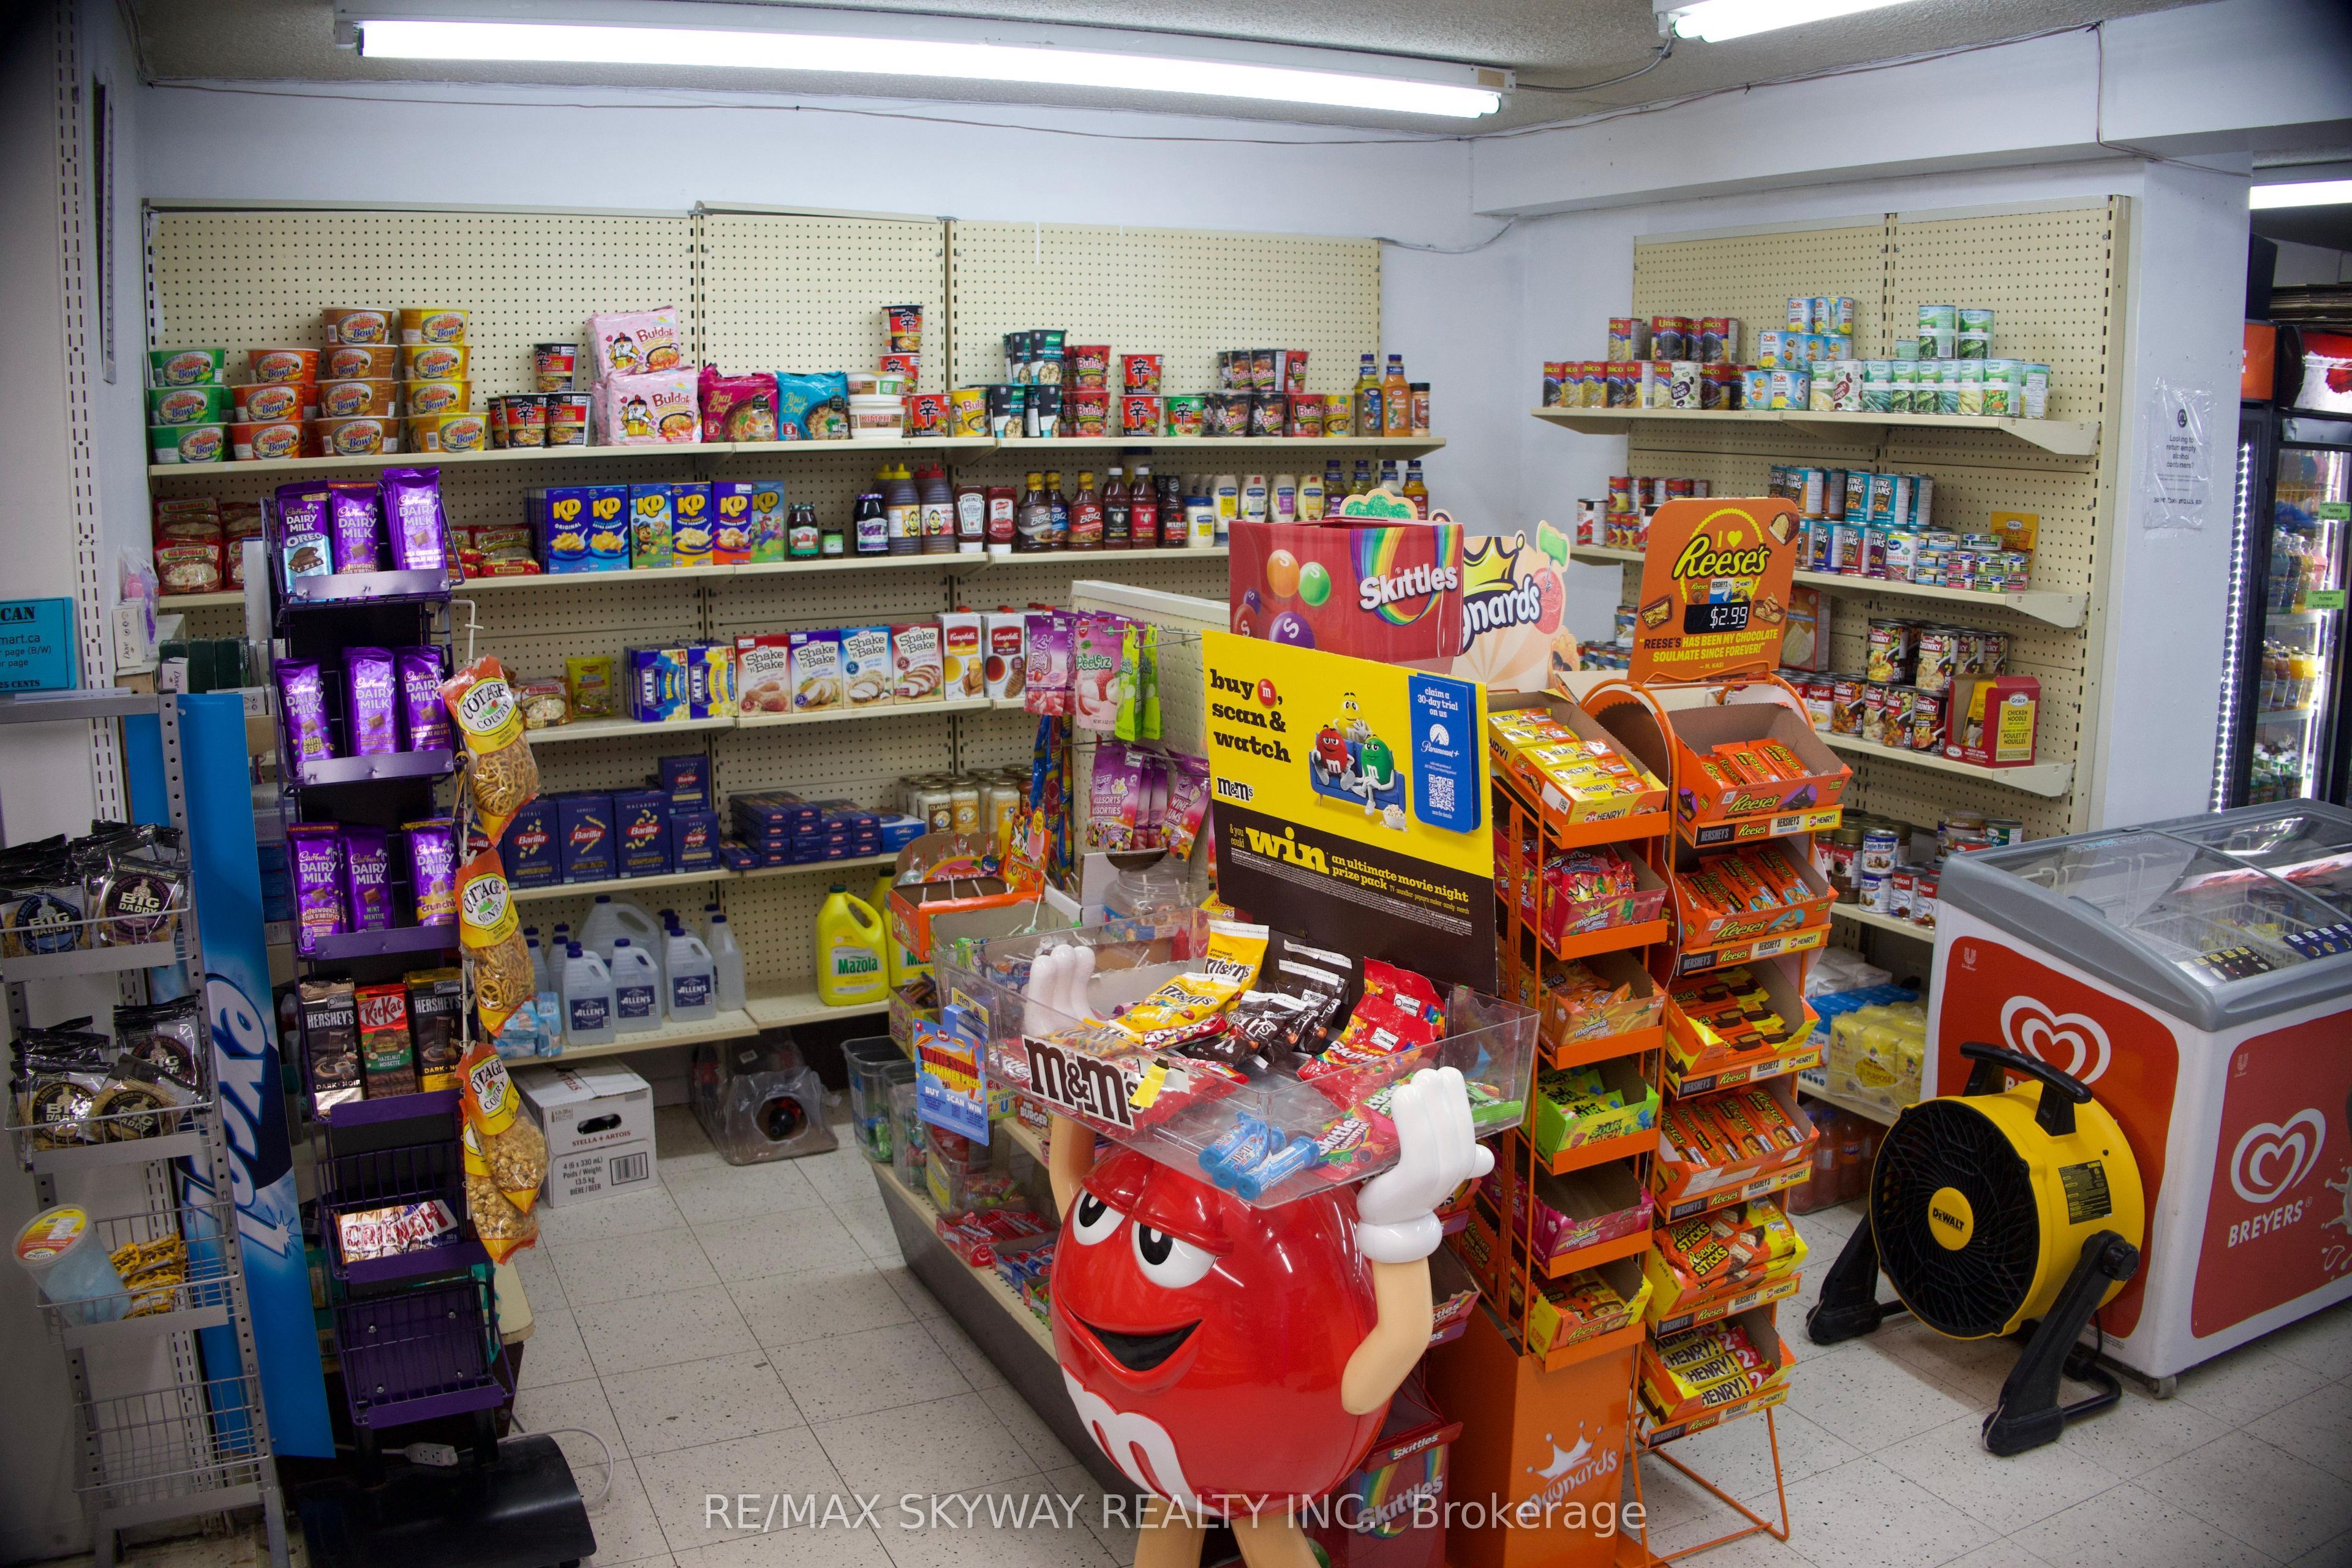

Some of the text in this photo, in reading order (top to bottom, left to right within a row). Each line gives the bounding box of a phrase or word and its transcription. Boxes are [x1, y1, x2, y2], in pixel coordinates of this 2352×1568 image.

[1659, 319, 1683, 328] Unico
[437, 326, 458, 337] Bowl
[636, 326, 674, 343] Buldak
[428, 361, 450, 373] Bowl
[1131, 358, 1151, 385] 辛
[424, 397, 447, 410] Bowl
[651, 391, 692, 409] Buldak
[711, 390, 731, 404] Thai
[337, 398, 360, 411] Bowl
[861, 414, 892, 423] KIMCHI
[1129, 400, 1150, 427] 辛
[786, 424, 793, 433] 5
[349, 434, 372, 448] Bowl
[456, 430, 477, 443] Bowl
[2180, 445, 2196, 454] empty
[592, 497, 622, 521] KD
[636, 495, 666, 518] KD
[677, 494, 706, 518] KD
[720, 494, 748, 517] KD
[752, 491, 780, 514] KD
[287, 514, 318, 525] DAIRY
[338, 518, 377, 529] DAIRY
[1031, 512, 1051, 526] BBQ
[1079, 511, 1102, 524] BBQ
[290, 522, 315, 532] MILK
[342, 527, 374, 538] MILK
[285, 533, 323, 548] OREO
[1717, 530, 1723, 548] I
[1672, 533, 1770, 579] Reese's
[1359, 564, 1457, 609] Skittles
[1709, 606, 1748, 630] $2.99
[848, 635, 885, 652] Shake
[899, 631, 936, 647] Shake
[1683, 628, 1779, 647] HAS BEEN MY CHOCOLATE
[28, 645, 51, 654] (B/W)
[798, 645, 835, 661] Shake
[858, 645, 885, 658] Bake
[908, 641, 937, 654] Bake
[745, 650, 784, 667] Shake
[1653, 647, 1724, 662] SOULMATE SINCE
[9, 660, 29, 668] page
[755, 660, 785, 673] Bake
[808, 655, 835, 668] Bake
[1210, 669, 1254, 701] buy
[285, 691, 325, 706] DAIRY
[355, 687, 395, 699] DAIRY
[1425, 687, 1444, 698] claim
[360, 699, 391, 709] MILK
[1417, 695, 1458, 710] 30-day trial
[291, 705, 323, 717] MILK
[1430, 708, 1438, 717] on
[1212, 703, 1286, 733] scan &
[303, 736, 323, 745] Mini
[1213, 731, 1291, 763] watch
[303, 743, 325, 754] Eggs
[626, 801, 660, 810] MACARONI
[1727, 794, 1781, 813] Reese's
[1597, 808, 1626, 821] HENRY!
[1777, 816, 1800, 827] HERSHEY'S
[575, 829, 601, 840] Barilla
[630, 826, 658, 835] Barilla
[1235, 827, 1244, 838] you
[1738, 824, 1766, 837] Reese's
[518, 834, 546, 845] Barilla
[1231, 837, 1245, 848] could
[415, 844, 447, 855] Cadbury
[1246, 826, 1329, 875] win
[1877, 842, 1895, 851] Brand
[350, 853, 380, 864] Cadbury
[417, 853, 454, 866] DAIRY
[300, 862, 337, 873] DAIRY
[352, 863, 387, 874] DAIRY
[421, 864, 452, 875] MILK
[1561, 865, 1601, 875] Gummies
[303, 872, 334, 883] MILK
[356, 873, 385, 884] MILK
[1332, 865, 1387, 891] prize pack
[1332, 854, 1469, 903] an ultimate movie night
[119, 892, 160, 908] BIG
[1715, 921, 1769, 939] Reese's
[1758, 939, 1781, 951] HERSHEY'S
[1211, 948, 1234, 957] peanut
[839, 957, 878, 974] Mazola
[677, 982, 710, 995] ALLEN'S
[619, 994, 654, 1007] ALLEN'S
[364, 996, 404, 1025] KitKat
[576, 1005, 607, 1018] ALLEN'S
[307, 1010, 355, 1029] HERSHEY'S
[920, 1046, 948, 1067] WIN
[1796, 1054, 1814, 1065] HENRY!
[1757, 1060, 1779, 1072] HERSHEY'S
[924, 1062, 982, 1090] SUMMER PRIZES
[316, 1081, 338, 1090] DARK
[925, 1086, 940, 1097] BUY
[946, 1094, 965, 1107] SCAN
[968, 1102, 982, 1115] WIN
[1020, 1107, 1048, 1127] BURGER
[1592, 1121, 1622, 1137] SOUR
[572, 1130, 631, 1147] STELLA ARTOIS
[1317, 1117, 1364, 1156] Skittles
[1787, 1169, 1806, 1180] HENRY!
[1748, 1178, 1771, 1190] HERSHEY'S
[1711, 1191, 1738, 1205] Reese's
[345, 1200, 448, 1247] CRUNCH
[2228, 1199, 2304, 1248] BREYERS
[1697, 1306, 1725, 1321] Reese's
[1717, 1332, 1736, 1351] 2
[1667, 1338, 1720, 1367] HENRY!
[1736, 1349, 1754, 1368] 2
[1687, 1354, 1738, 1383] HENRY!
[1392, 1434, 1439, 1460] Skittles
[1355, 1474, 1444, 1534] Skittles
